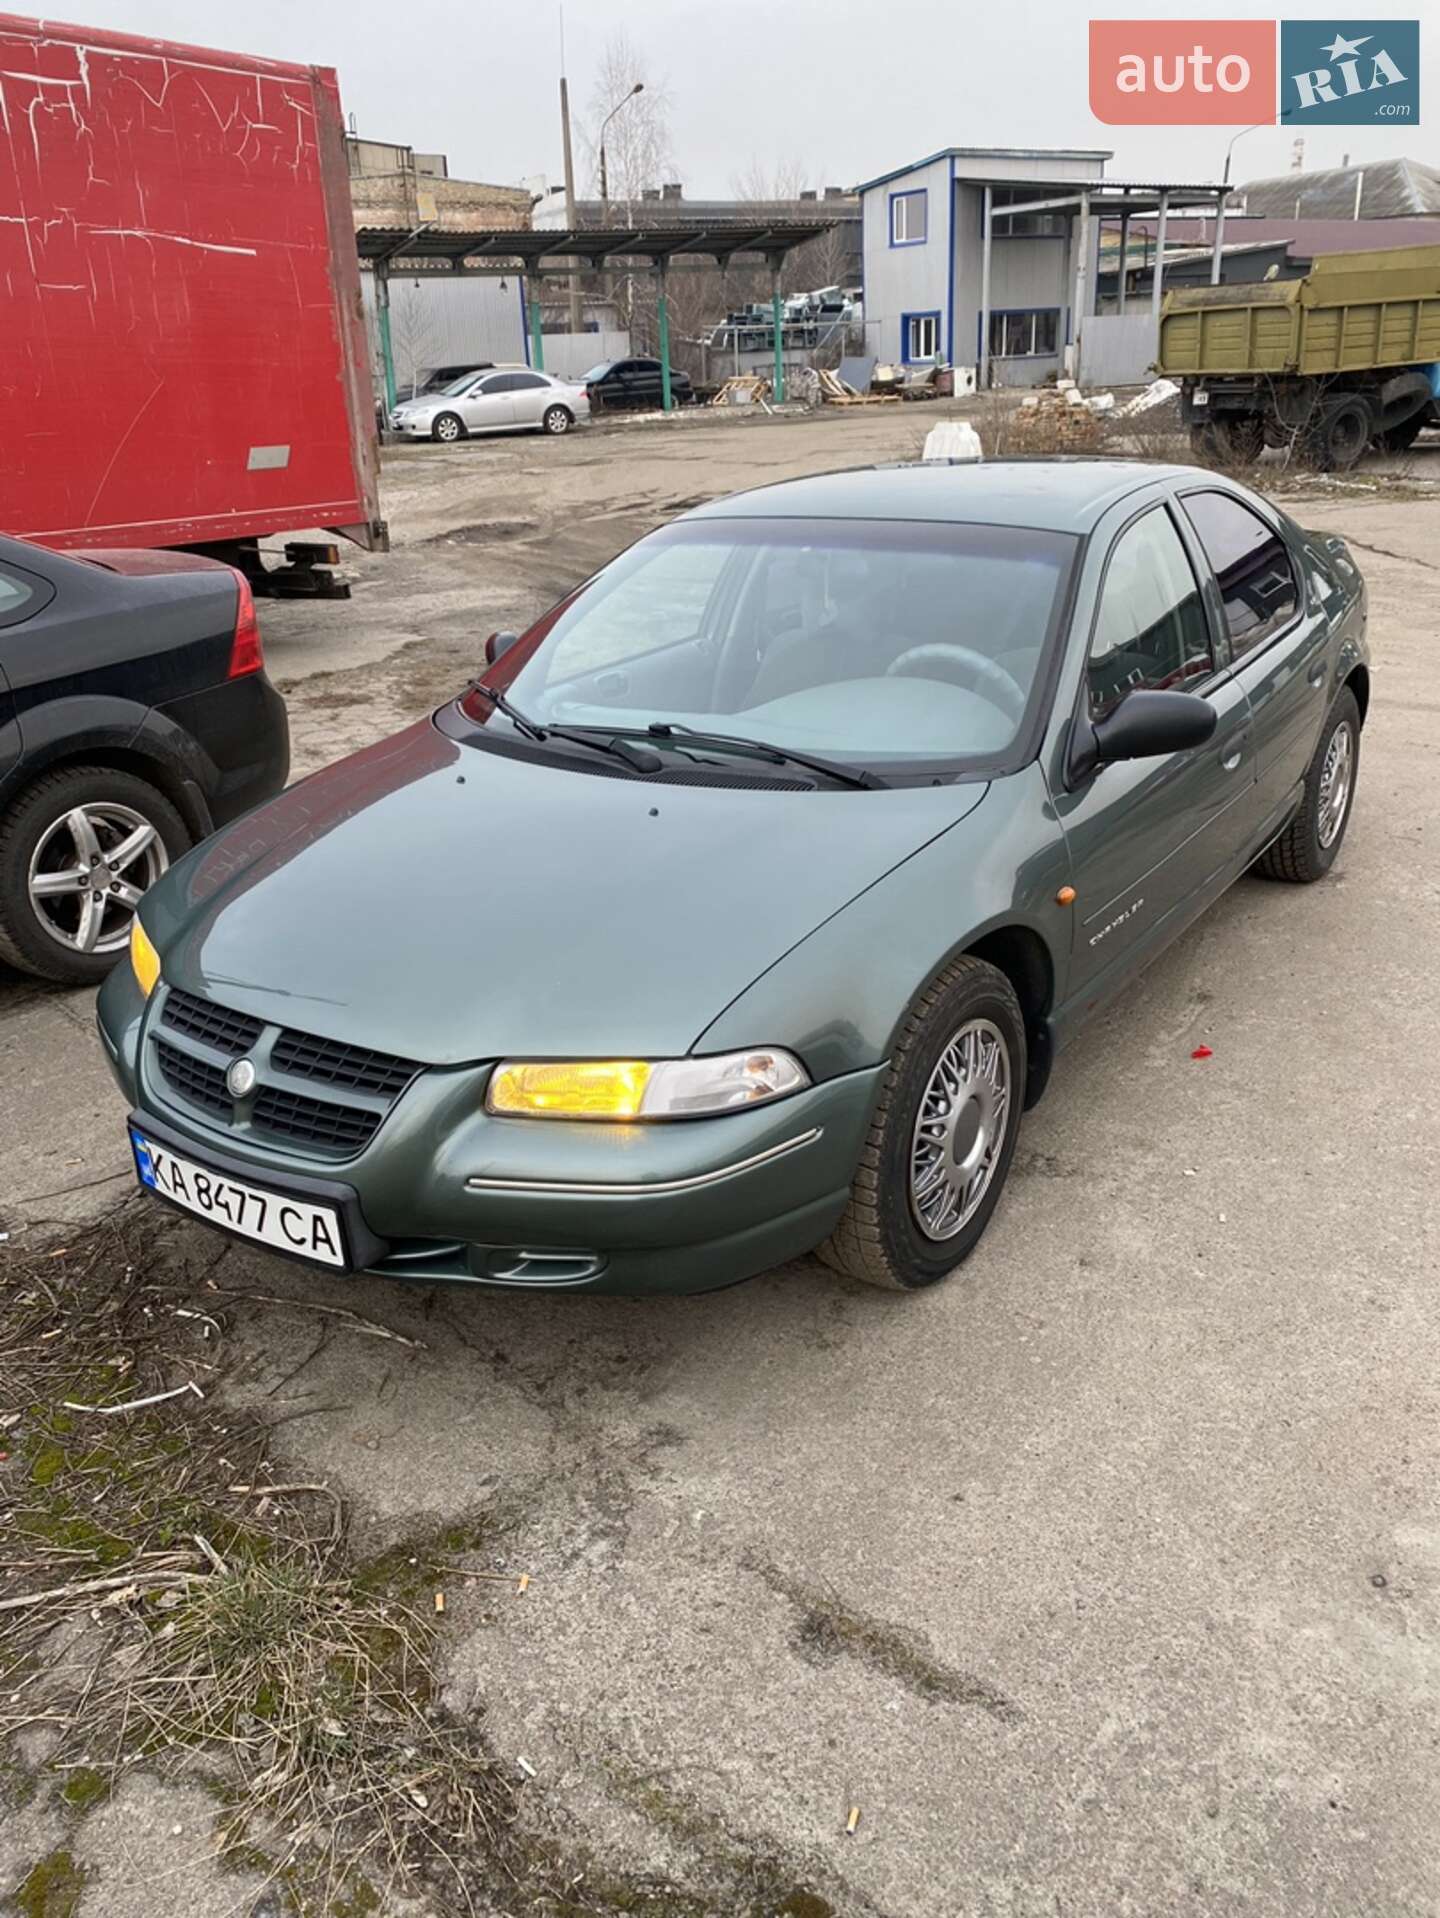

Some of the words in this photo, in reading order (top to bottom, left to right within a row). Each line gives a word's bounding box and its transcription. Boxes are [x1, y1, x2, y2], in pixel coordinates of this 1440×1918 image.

[147, 1147, 191, 1201] KA
[194, 1172, 267, 1232] 8477
[280, 1206, 337, 1257] CA
